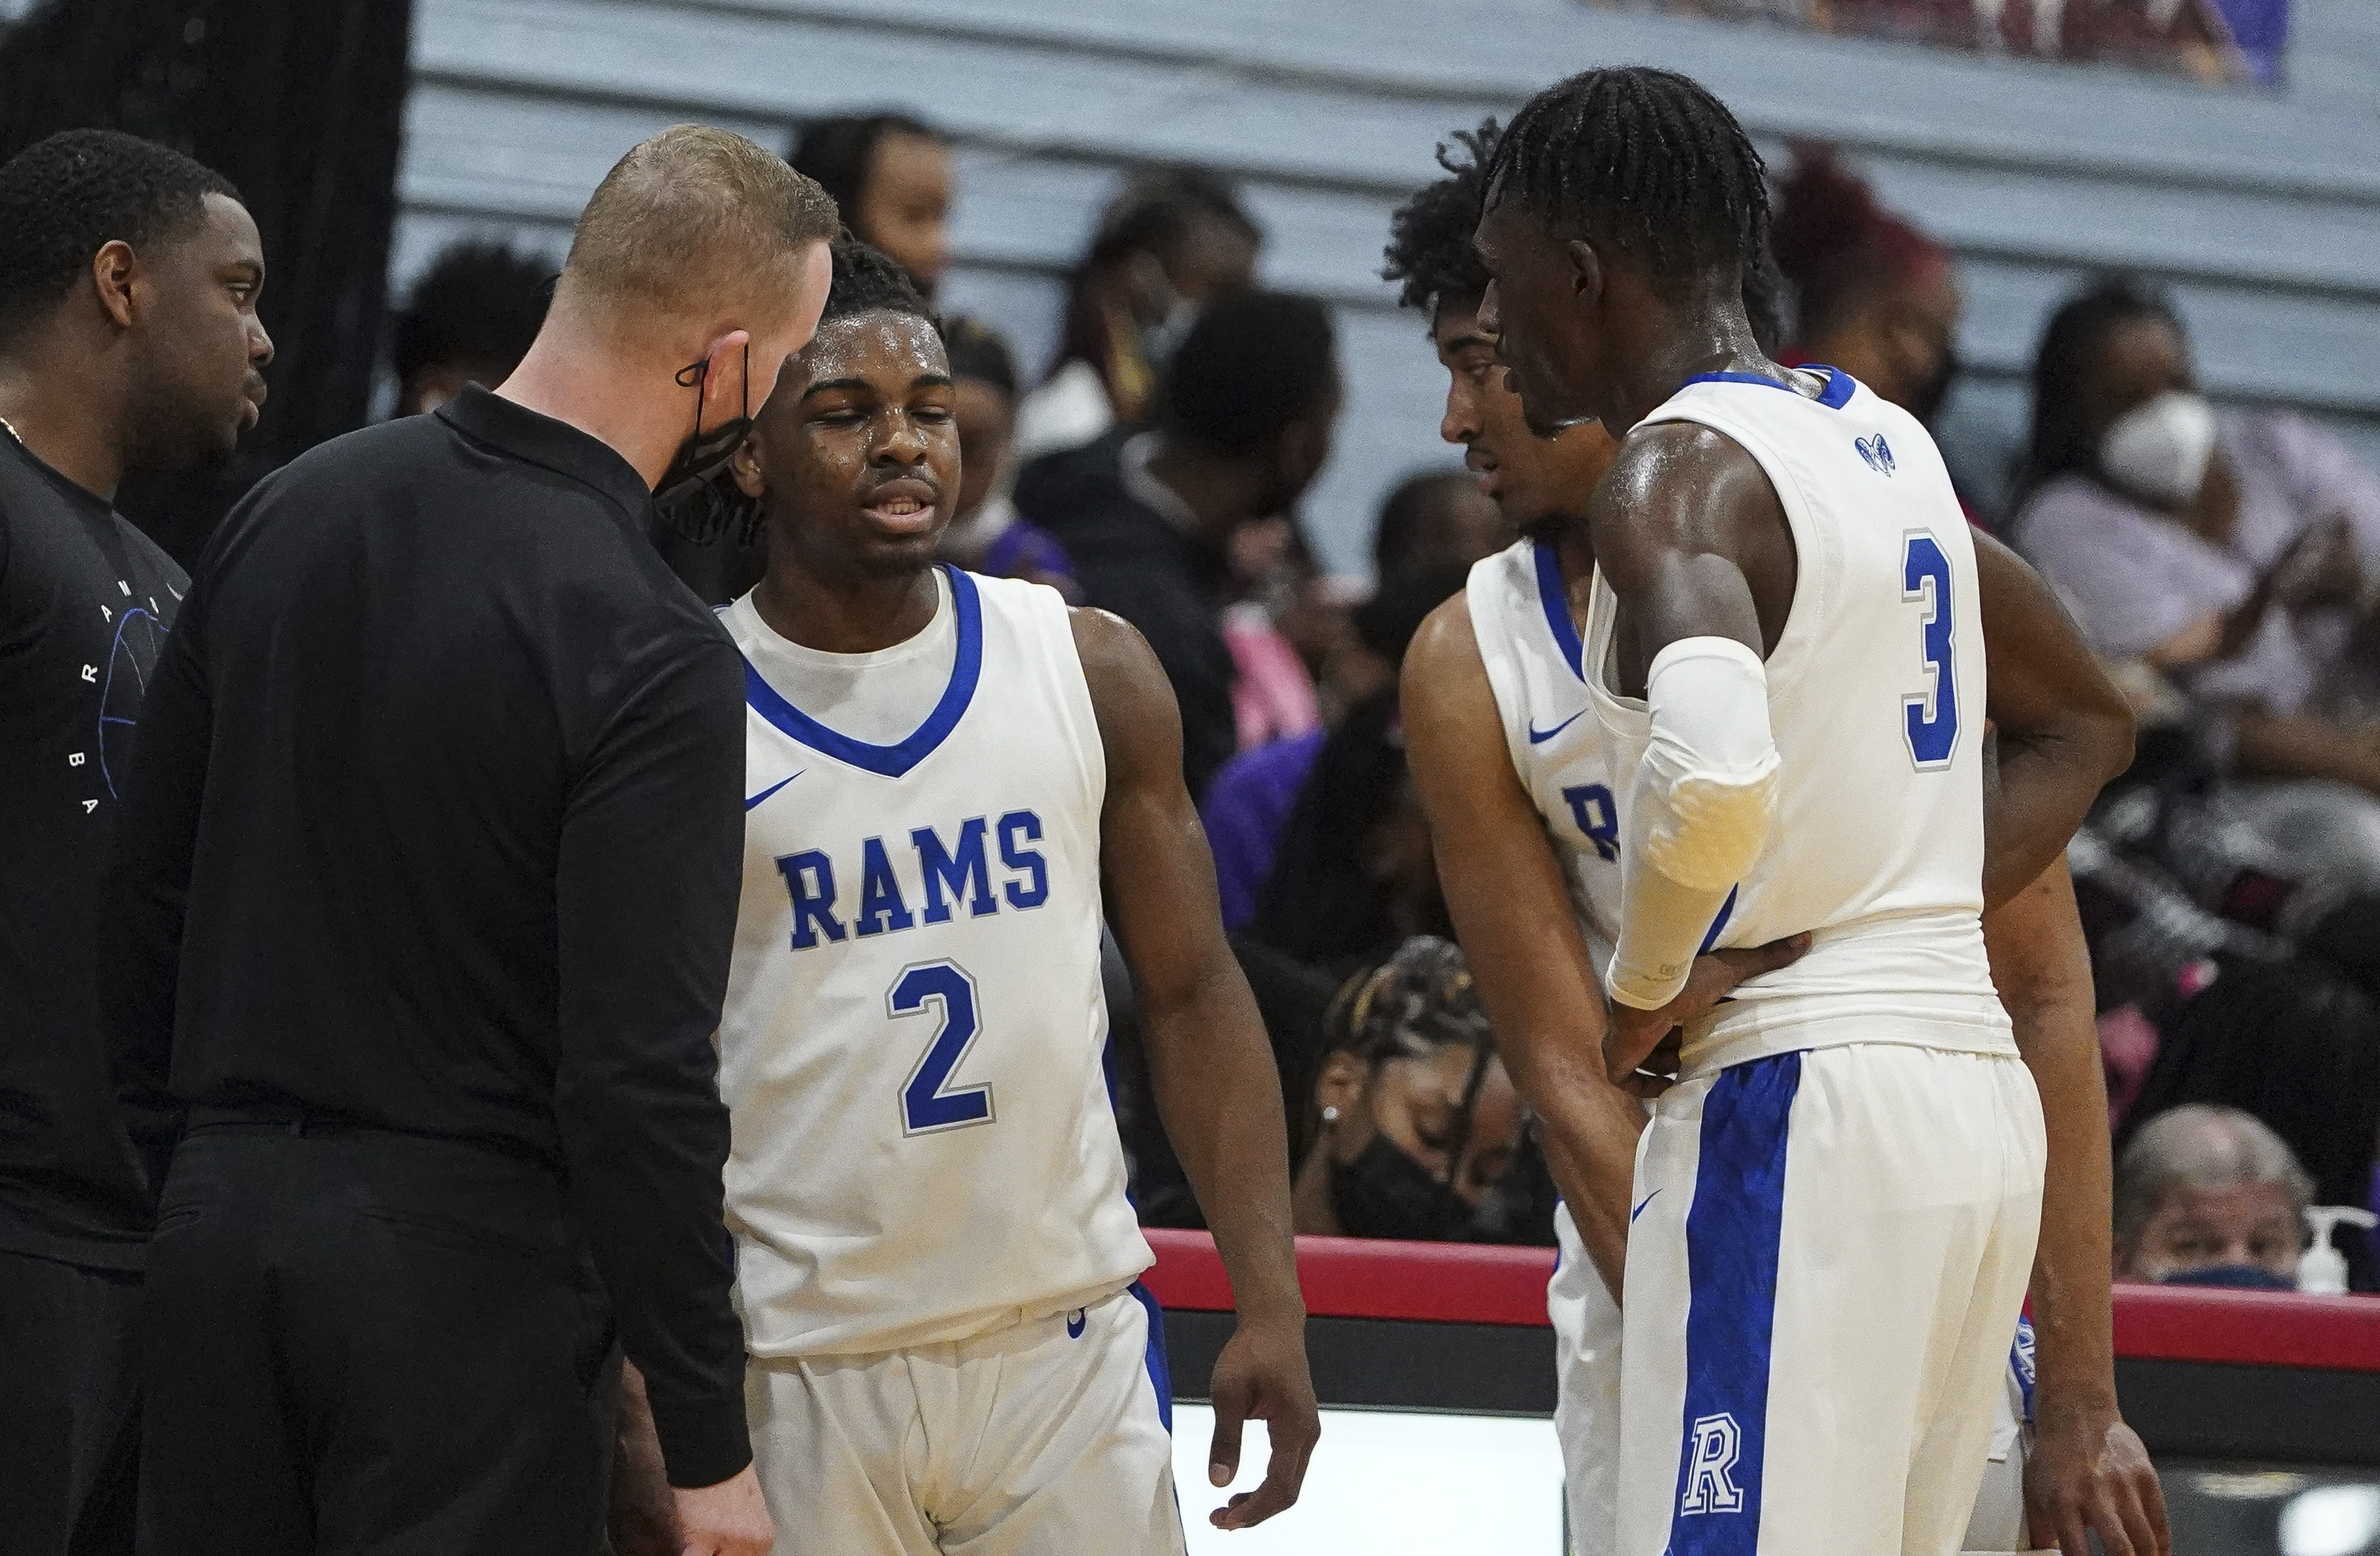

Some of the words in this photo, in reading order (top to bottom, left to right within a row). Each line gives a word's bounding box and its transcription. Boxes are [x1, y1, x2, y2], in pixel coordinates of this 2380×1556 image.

[1901, 527, 1961, 773] 3
[774, 808, 1050, 952] RAMS
[885, 957, 996, 1138] 2
[1681, 1412, 1744, 1517] R
